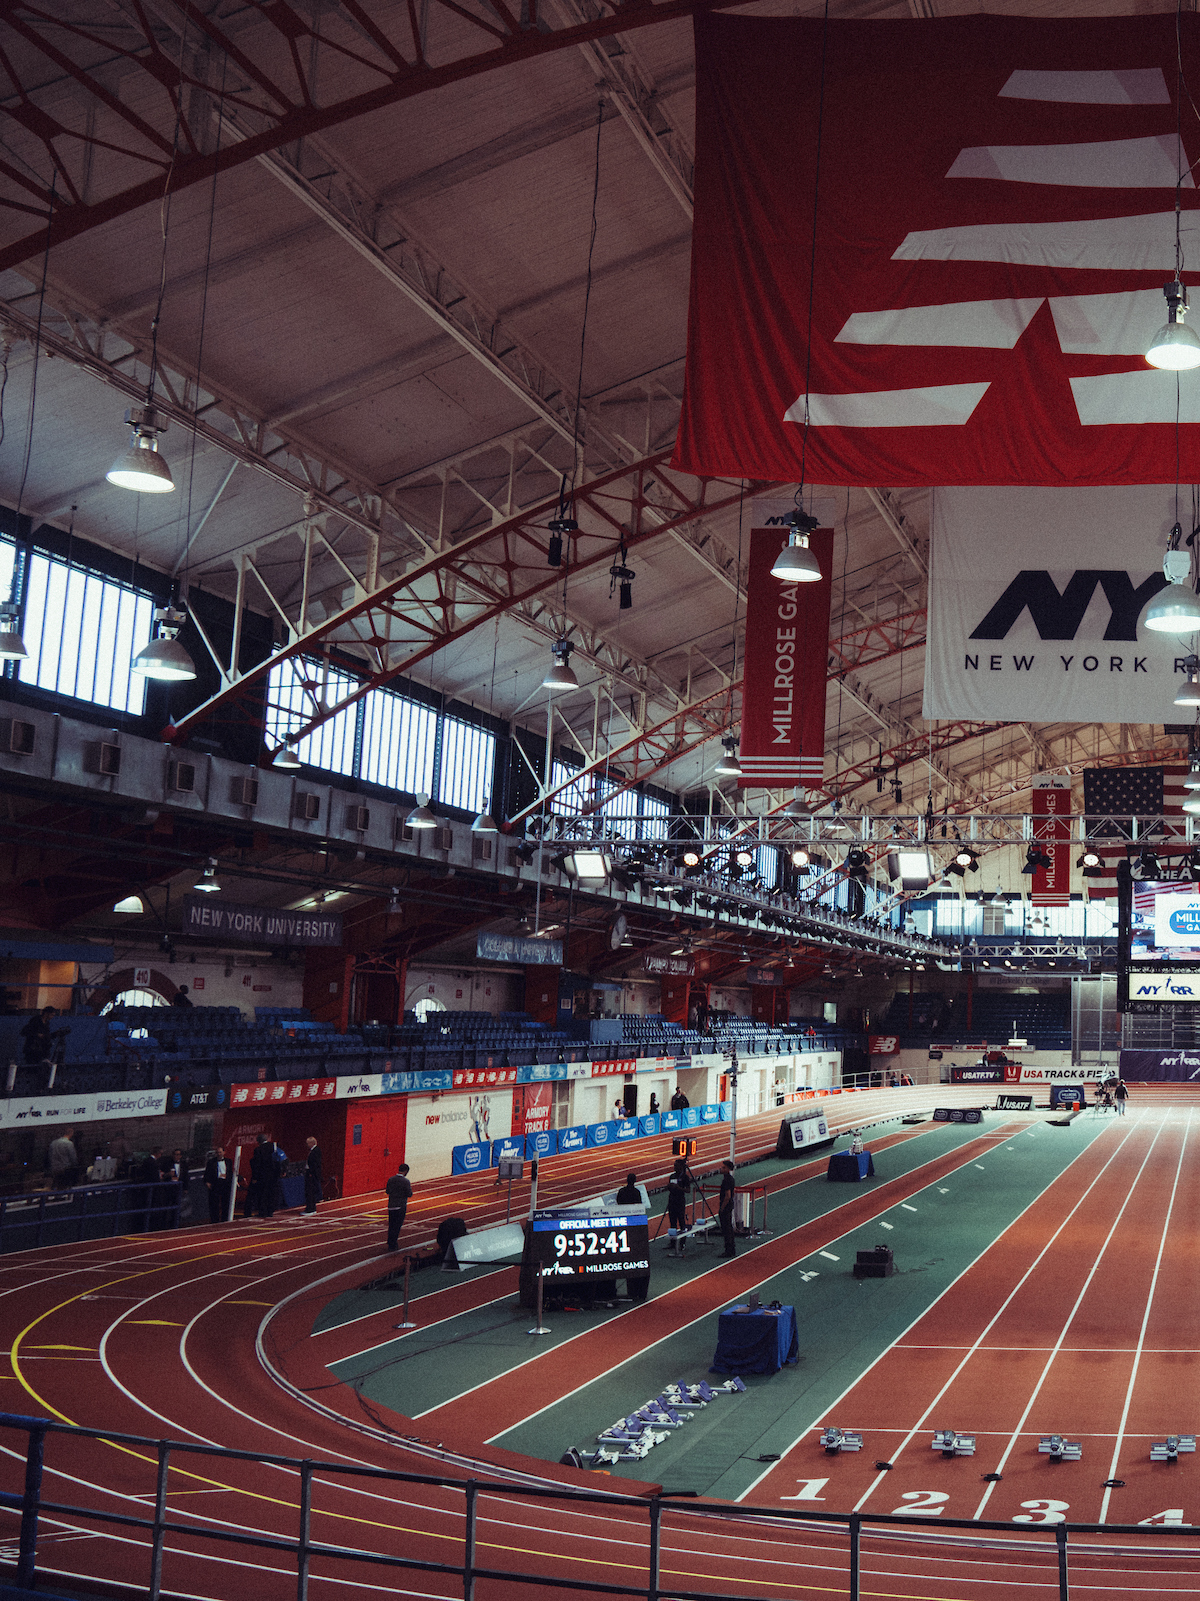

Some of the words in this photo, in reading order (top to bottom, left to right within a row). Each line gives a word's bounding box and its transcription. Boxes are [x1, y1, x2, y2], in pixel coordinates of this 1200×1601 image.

[964, 654, 1036, 672] NEW
[1061, 655, 1148, 674] YORK
[771, 626, 797, 744] MILLROSE
[190, 906, 223, 928] NEW
[227, 911, 262, 932] YORK
[267, 916, 336, 938] UNIVERSITY
[136, 970, 148, 984] 410
[1024, 1070, 1042, 1078] USA
[1044, 1070, 1077, 1078] TRACK
[1078, 1070, 1086, 1078] &
[105, 1097, 136, 1112] Berkeley
[137, 1095, 163, 1110] College
[190, 1092, 209, 1105] AT&T
[1006, 1102, 1030, 1110] USATF
[425, 1114, 440, 1126] new
[441, 1111, 468, 1124] balance
[526, 1106, 550, 1120] ARMORY
[559, 1218, 590, 1230] OFFICIAL
[591, 1218, 610, 1228] MEET
[610, 1217, 628, 1228] TIME
[554, 1230, 631, 1258] 9:52:41
[586, 1262, 622, 1274] MILLROSE
[623, 1260, 649, 1271] GAMES
[780, 1477, 831, 1501] 1
[892, 1490, 951, 1515] 2
[1012, 1499, 1071, 1524] 3
[1137, 1508, 1193, 1526] 4
